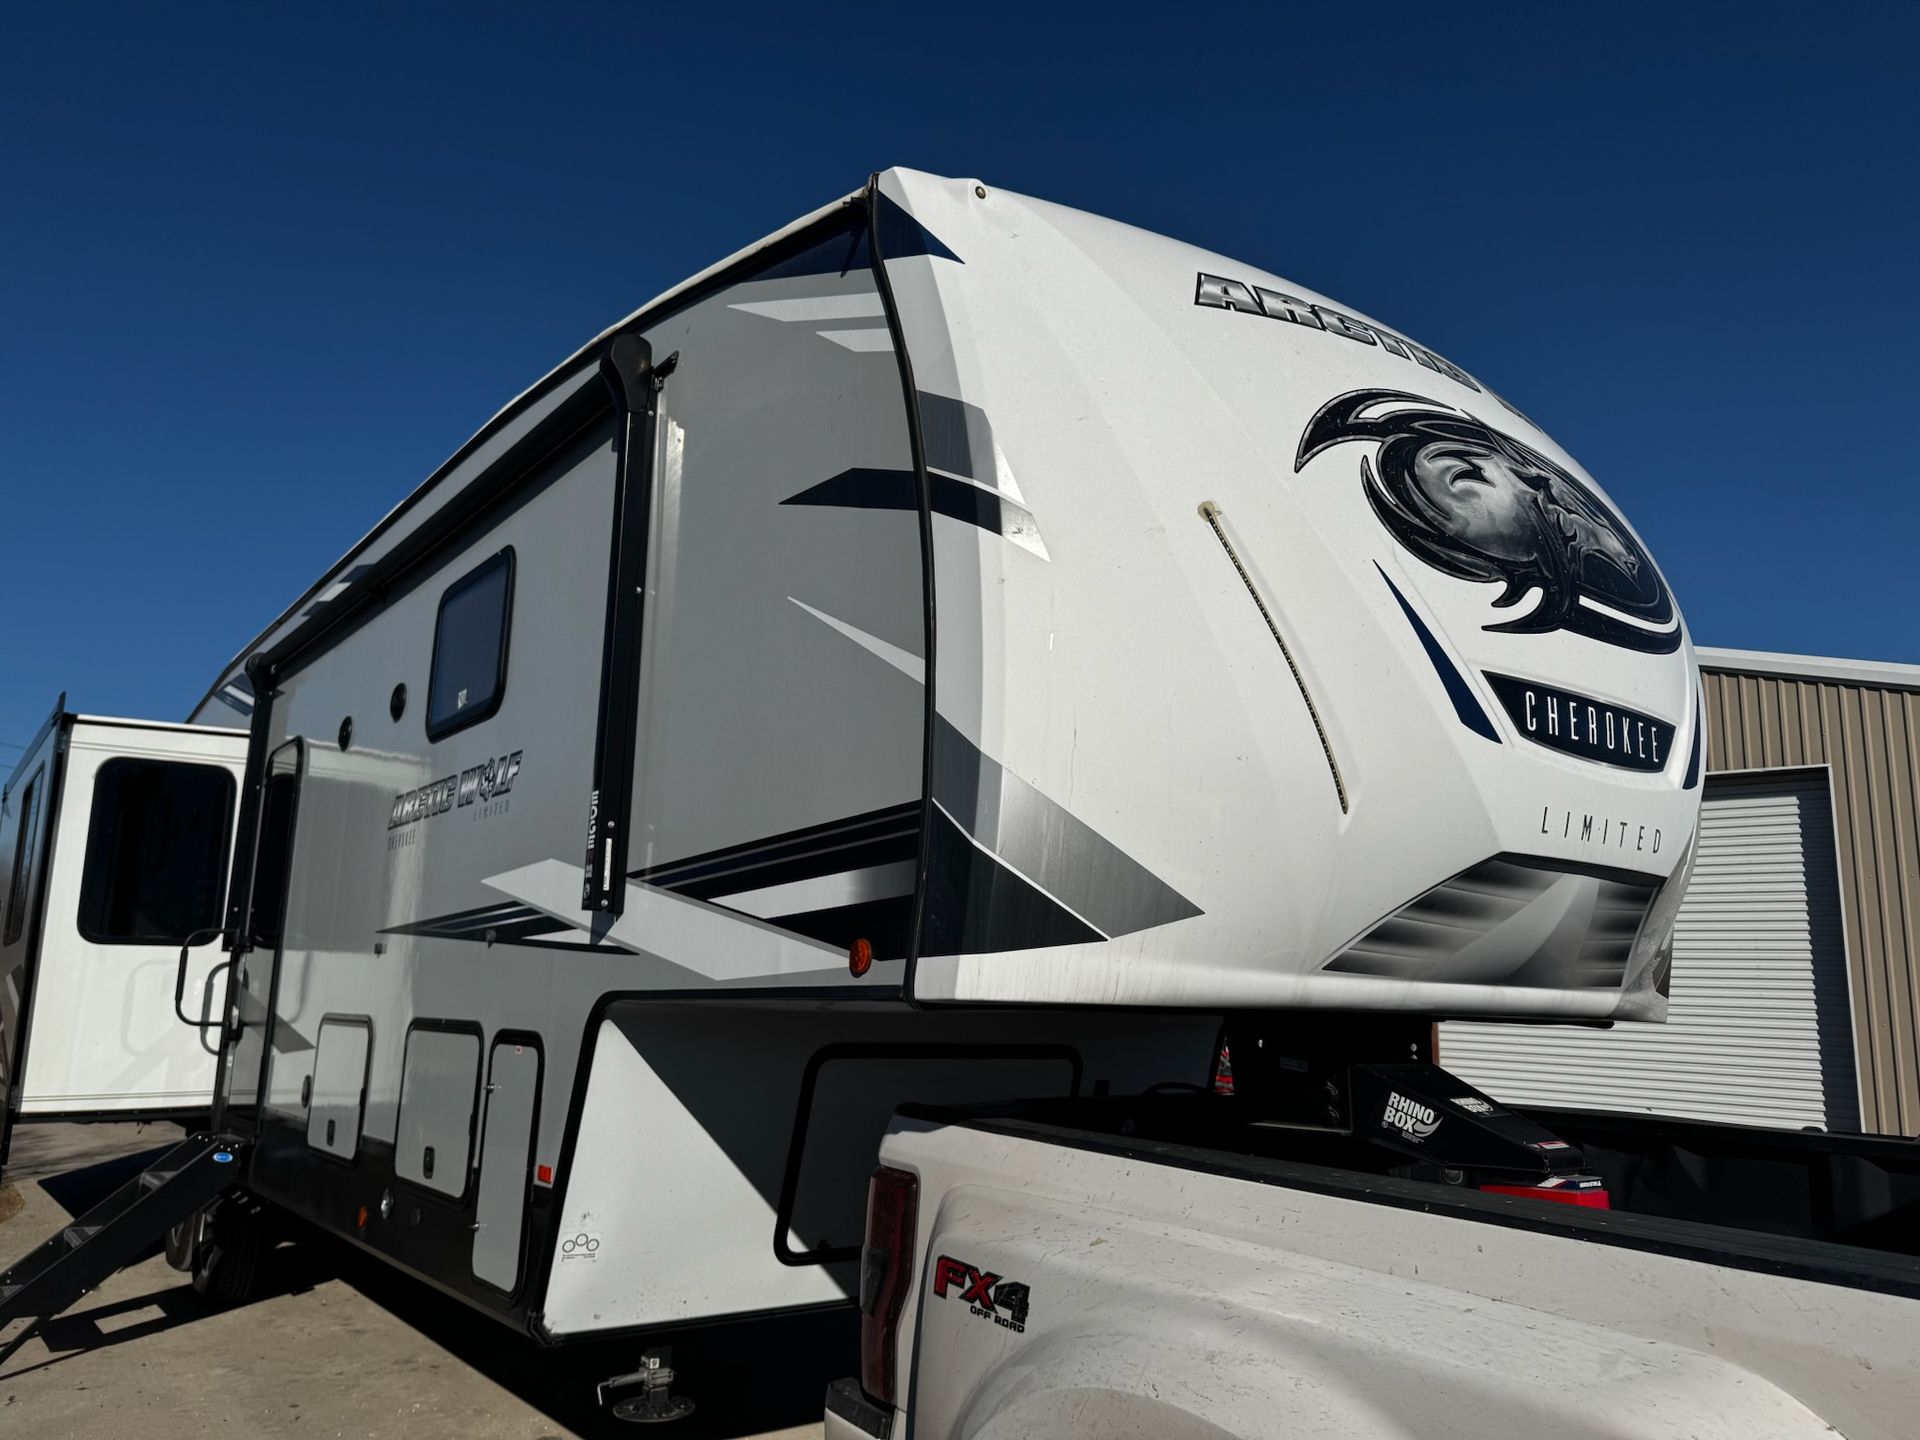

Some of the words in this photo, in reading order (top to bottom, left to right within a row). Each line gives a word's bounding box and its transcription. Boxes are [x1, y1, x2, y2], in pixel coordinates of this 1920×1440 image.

[1194, 271, 1482, 393] ARCTIC
[1525, 691, 1659, 763] CHEROKEE
[388, 774, 458, 831] ARCTIC
[1541, 806, 1662, 854] LIMITED
[1383, 1105, 1417, 1134] BOX
[1388, 1091, 1435, 1125] RHINO
[933, 1254, 1031, 1325] FX4
[969, 1305, 991, 1320] OFF
[994, 1314, 1025, 1334] ROAD
